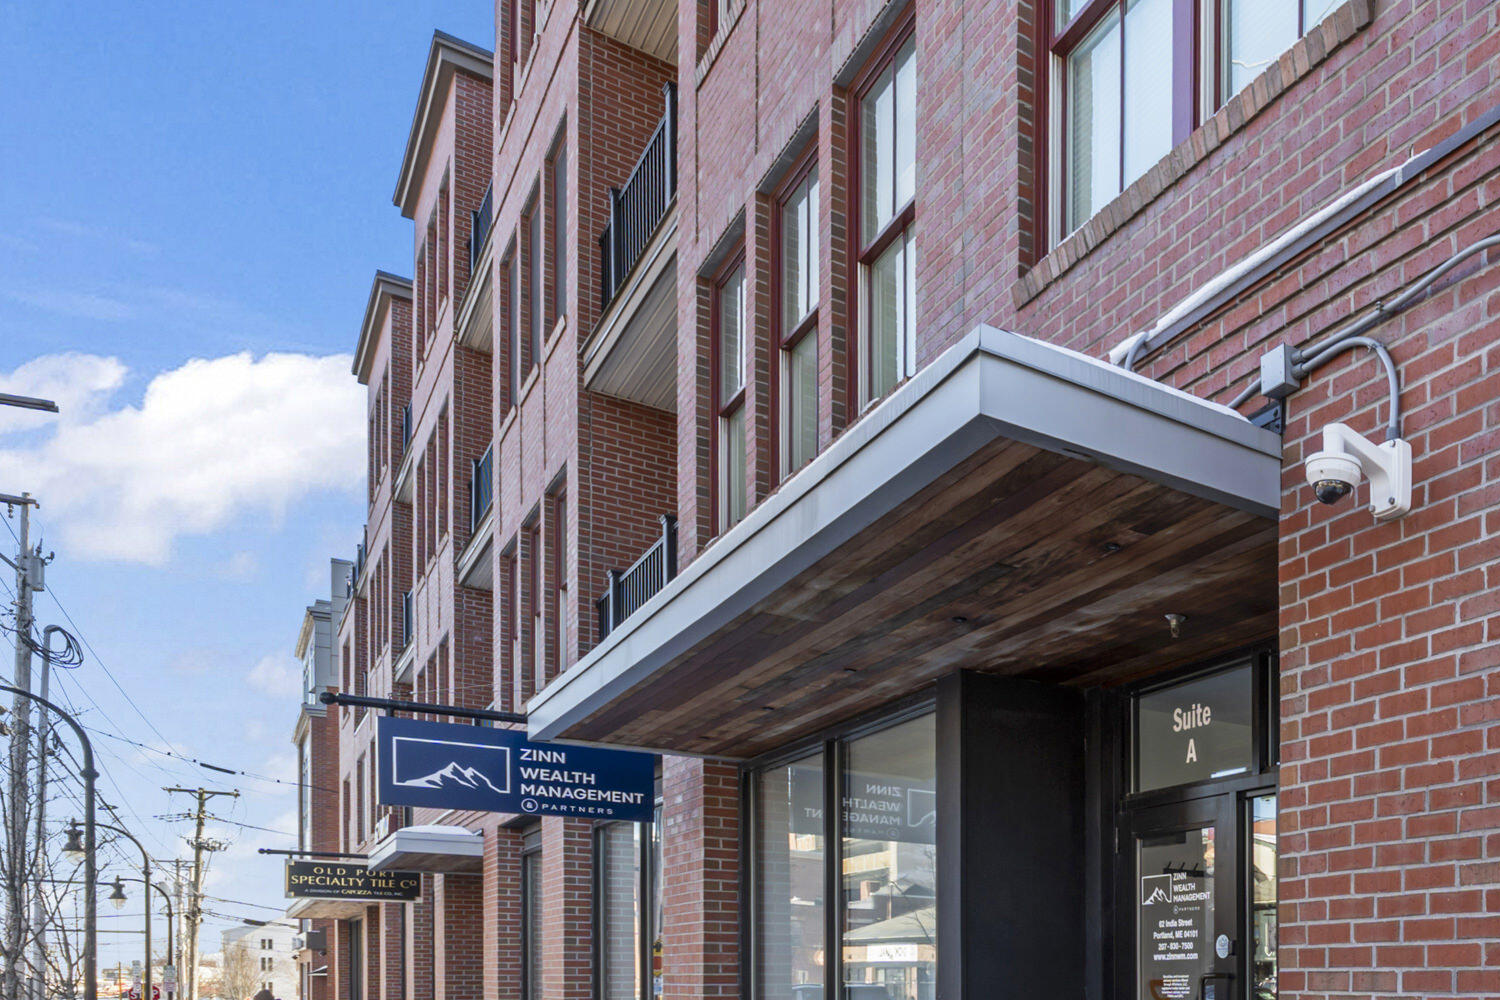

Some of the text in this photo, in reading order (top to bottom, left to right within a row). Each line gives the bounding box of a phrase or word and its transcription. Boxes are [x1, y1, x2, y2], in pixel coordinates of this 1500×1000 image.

[1173, 703, 1212, 732] Suite
[520, 748, 566, 764] ZINN
[1186, 738, 1197, 764] A
[520, 767, 596, 785] WEALTH
[521, 783, 645, 804] MANAGEMENT
[541, 803, 614, 815] PARTNERS
[313, 867, 346, 876] OLD
[1173, 872, 1187, 880] ZINN
[291, 875, 365, 886] SPECIALTY
[371, 878, 396, 888] TILE
[1173, 882, 1196, 892] WEALTH
[1173, 891, 1211, 902] MANAGEMENT
